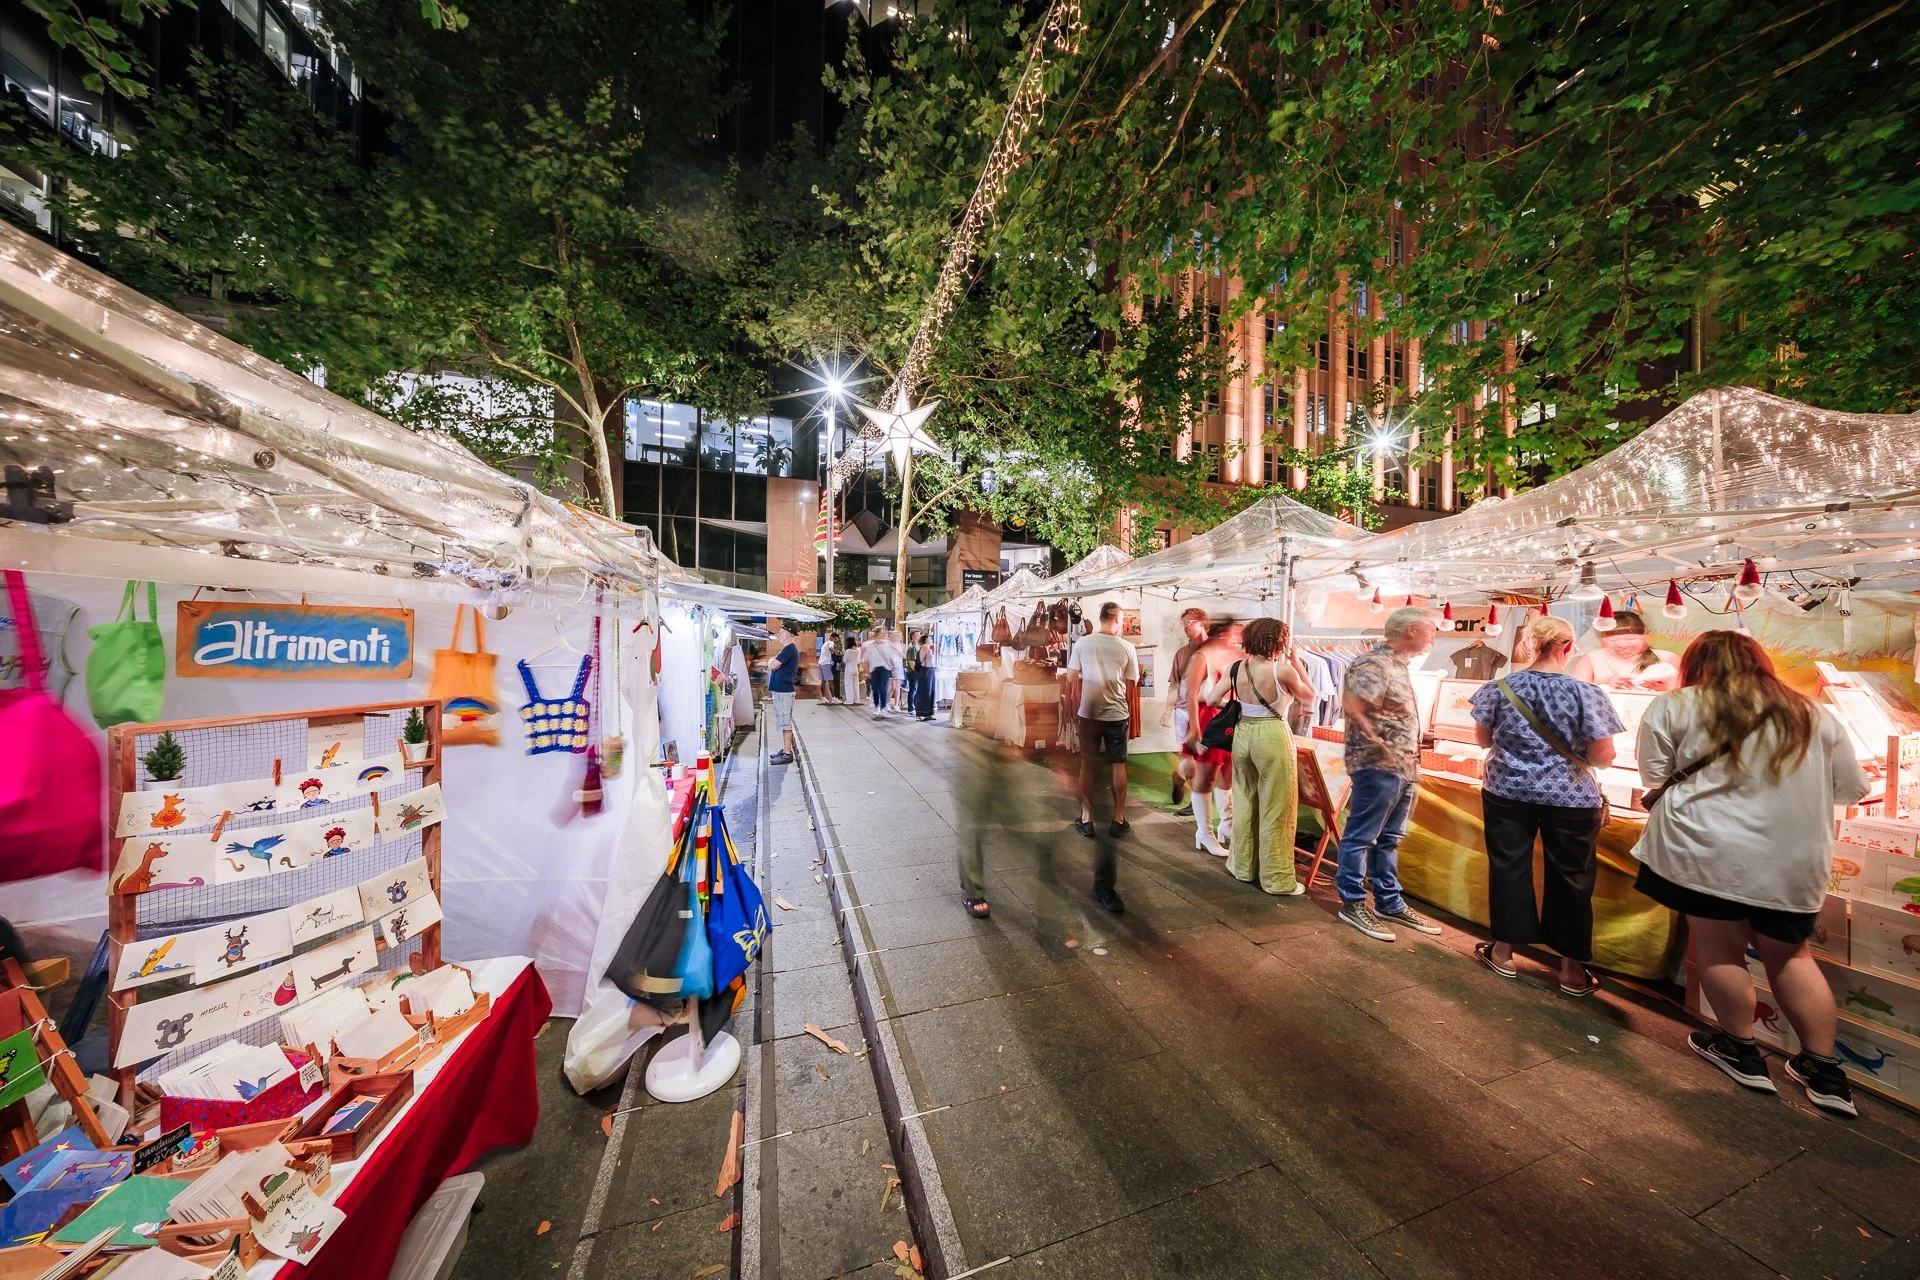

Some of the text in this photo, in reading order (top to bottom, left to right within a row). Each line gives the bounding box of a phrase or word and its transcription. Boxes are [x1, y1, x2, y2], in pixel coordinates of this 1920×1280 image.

[194, 620, 391, 666] altrimenti
[139, 1127, 188, 1160] handmade
[146, 1144, 178, 1168] LOVE
[284, 1207, 292, 1216] 4
